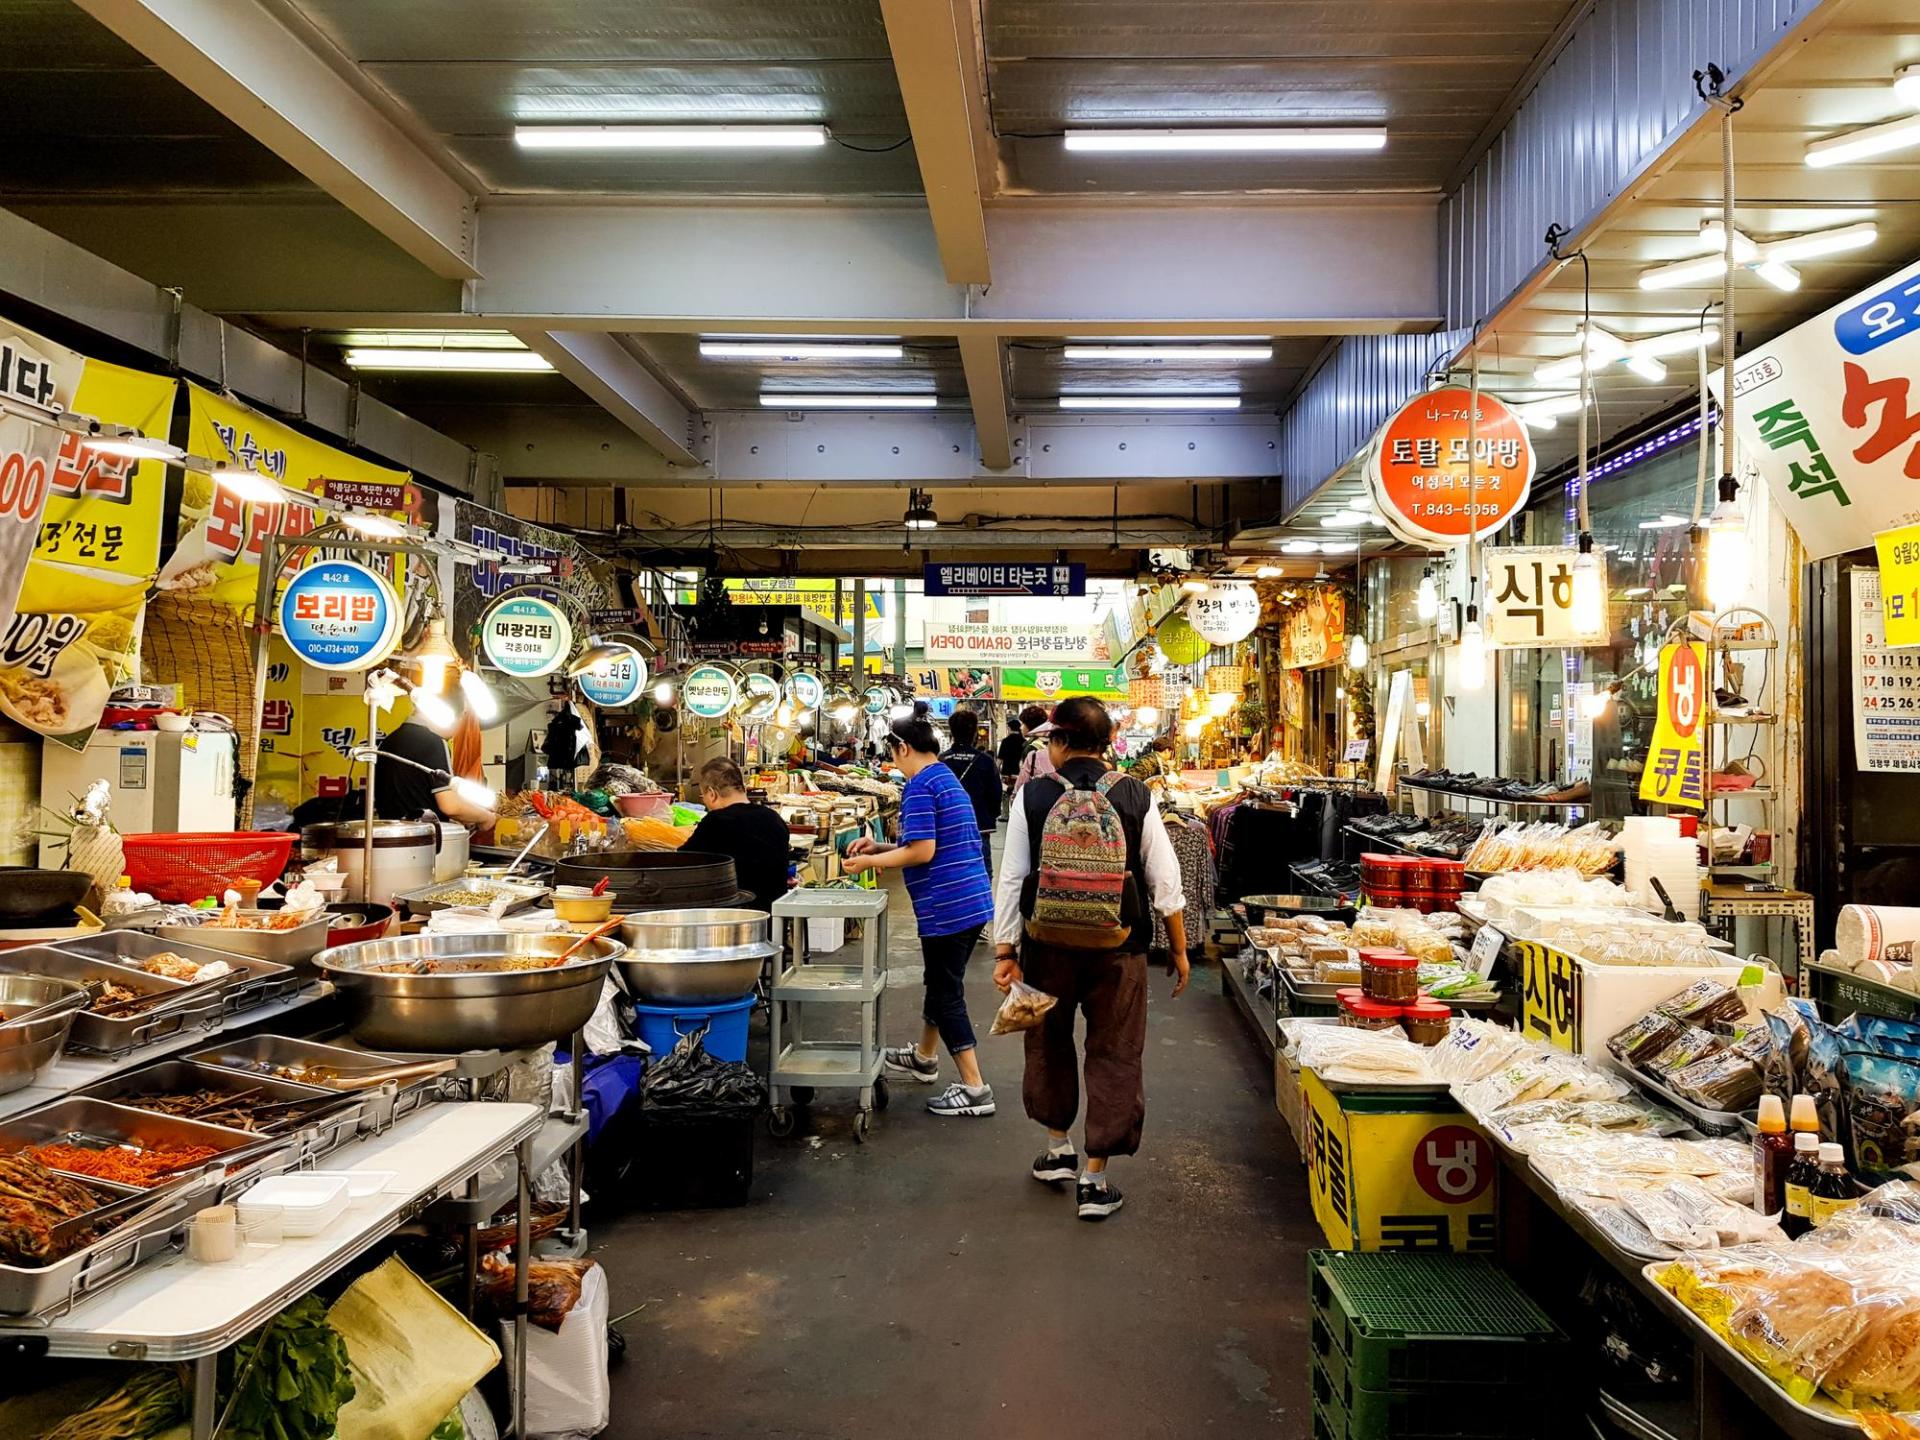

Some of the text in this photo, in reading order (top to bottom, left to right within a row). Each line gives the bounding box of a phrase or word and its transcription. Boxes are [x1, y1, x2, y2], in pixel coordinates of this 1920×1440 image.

[1862, 283, 1920, 339] 오
[1391, 437, 1521, 468] 토탈 모아방
[1753, 398, 1851, 507] 즉석
[329, 482, 400, 497] 아름답고 깨끗한 시장
[1412, 475, 1454, 490] 여성의
[334, 494, 393, 507] 어서오십시오
[940, 567, 1047, 586] 엘리베이터 타는곳
[1053, 585, 1070, 595] 2층
[295, 594, 377, 622] 보리밥
[1197, 598, 1222, 614] 왕의
[496, 623, 553, 640] 대광리집
[1866, 633, 1874, 644] 3
[1863, 655, 1912, 666] 10 11 12
[1863, 676, 1912, 687] 17 18 19
[1672, 664, 1696, 727] 냉
[1863, 697, 1914, 709] 24 25 26
[1426, 1140, 1478, 1196] 냉
